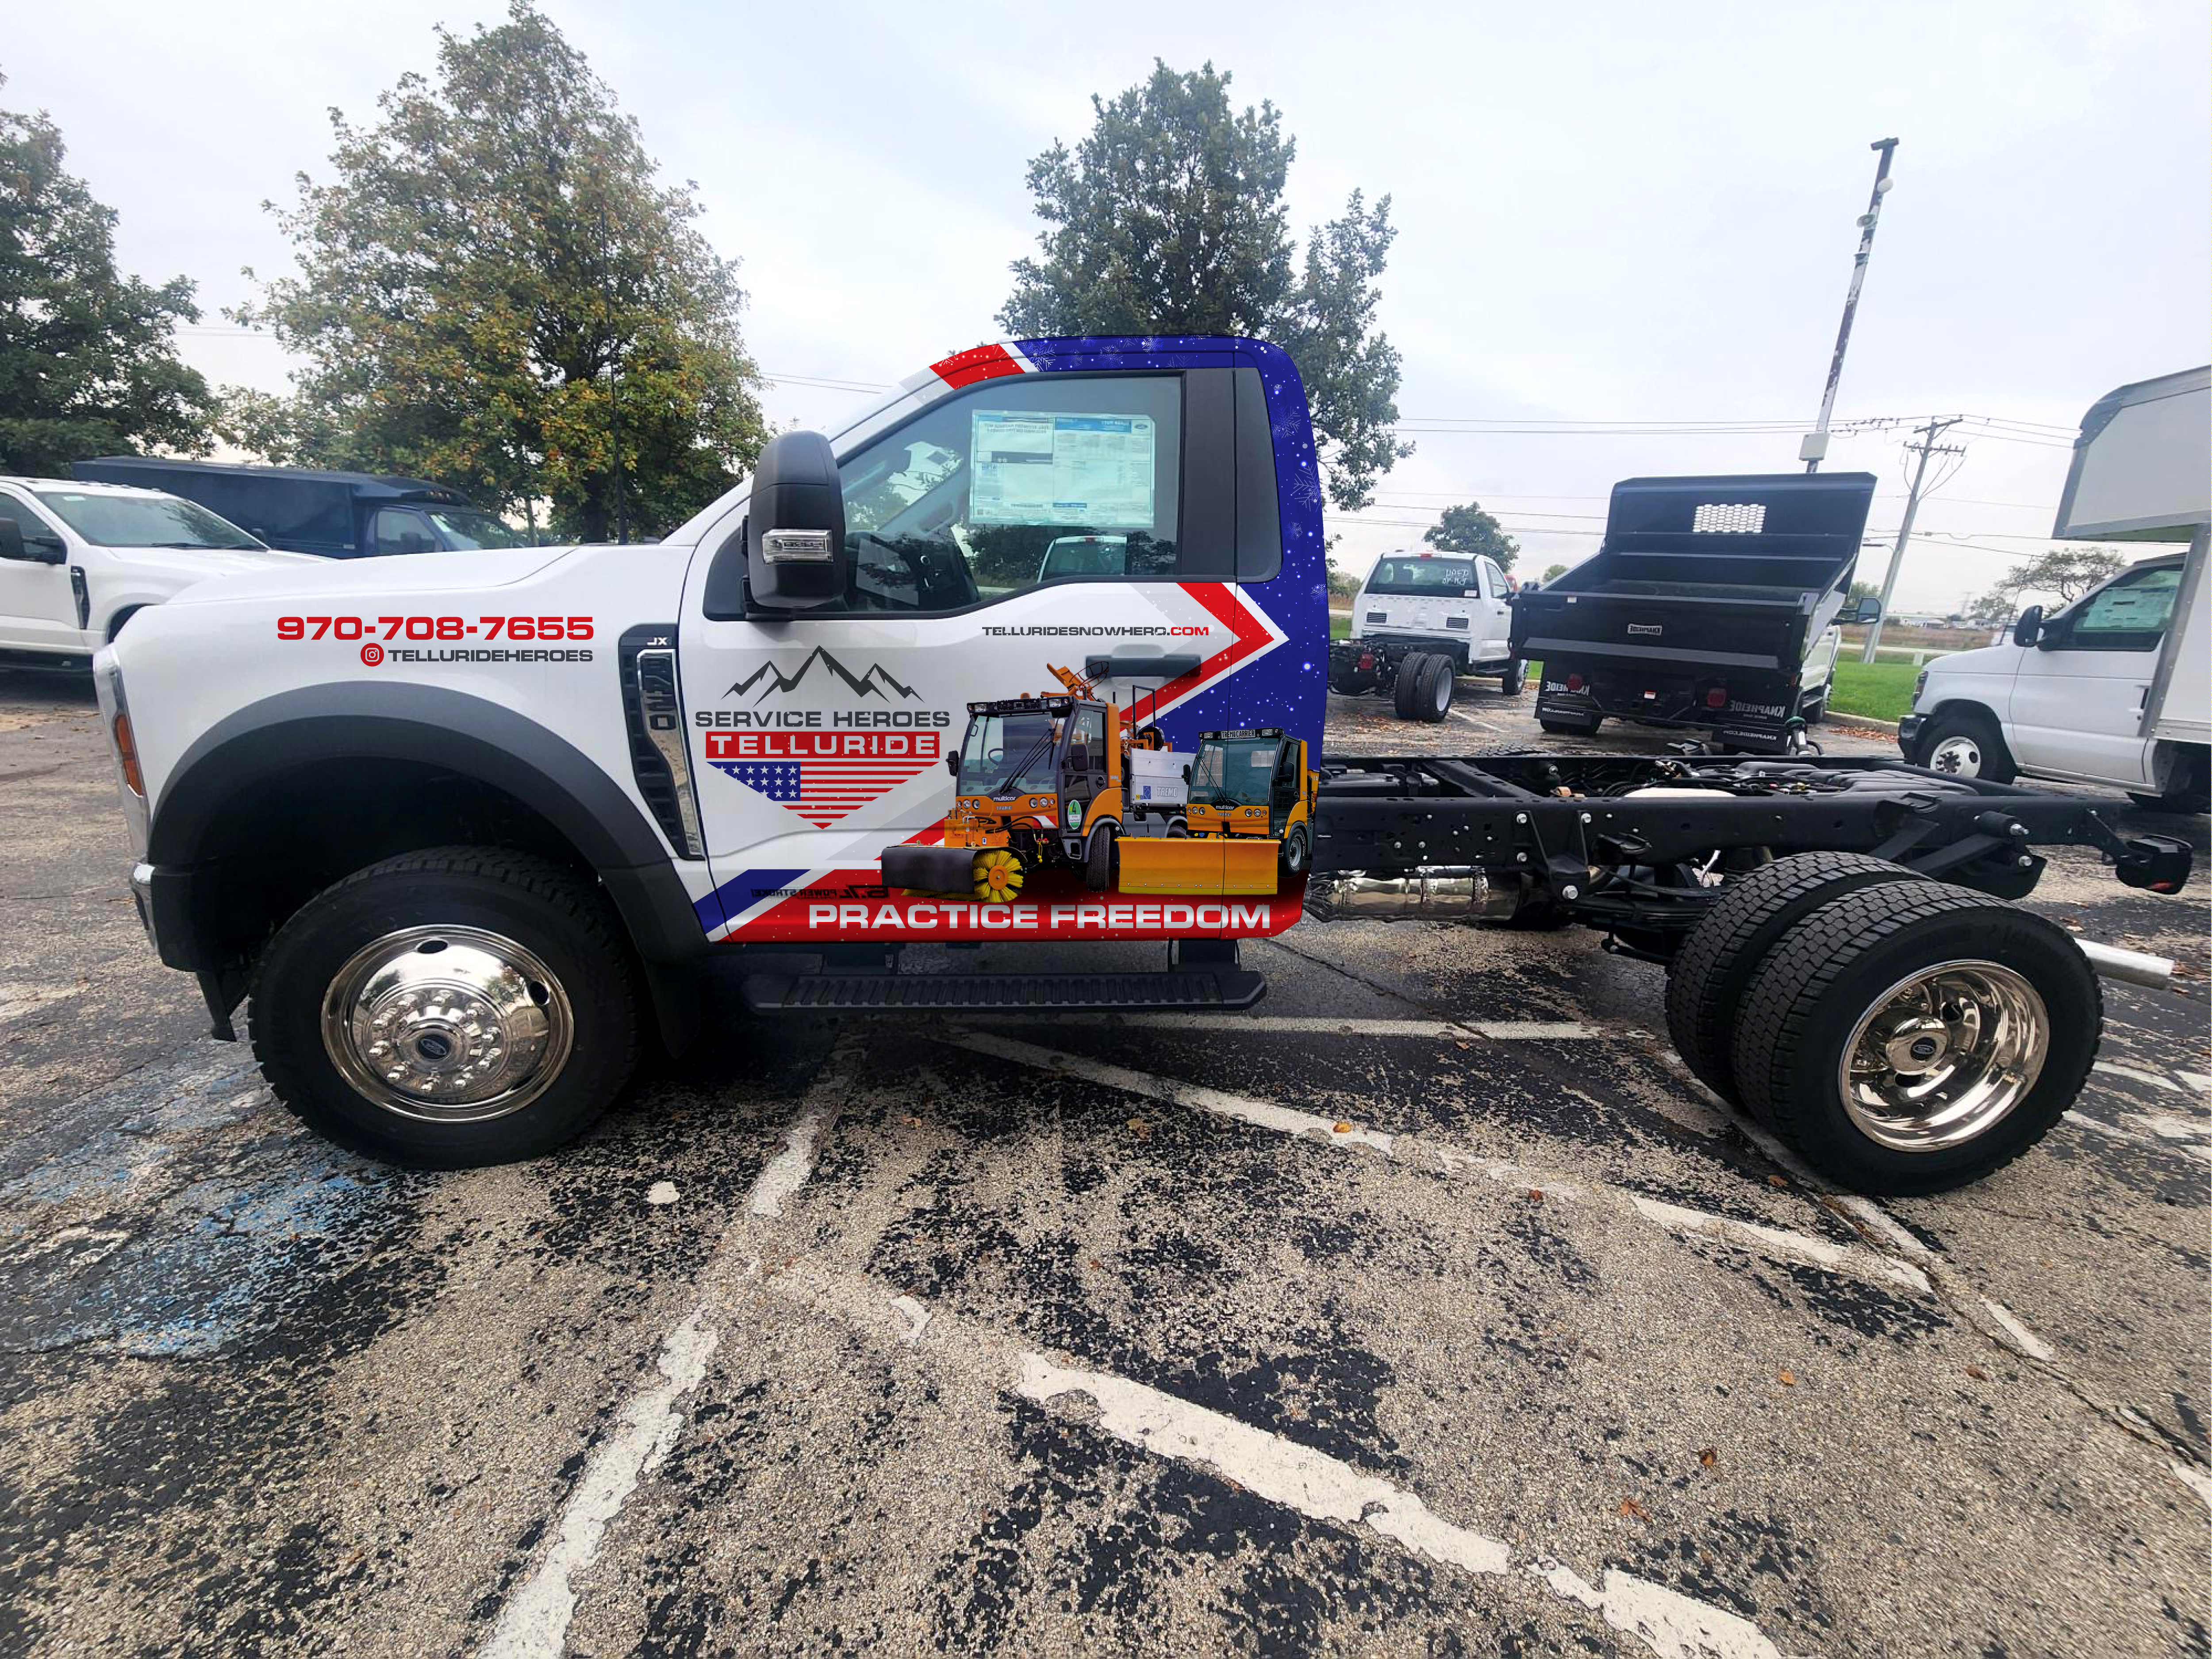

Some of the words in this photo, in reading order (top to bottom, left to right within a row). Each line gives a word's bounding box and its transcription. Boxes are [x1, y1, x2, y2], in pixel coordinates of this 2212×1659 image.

[277, 617, 594, 640] 970-708-7655
[982, 626, 1209, 636] TELLURIDESNOWHERO.COM
[388, 649, 593, 662] TELLURIDEHEROES
[695, 711, 822, 727] SERVICE
[833, 711, 950, 727] HEROES
[710, 735, 935, 755] TELLURIDE
[1157, 787, 1178, 797] TREMO
[809, 904, 1038, 929] PRACTICE
[1051, 904, 1270, 929] FREEDOM
